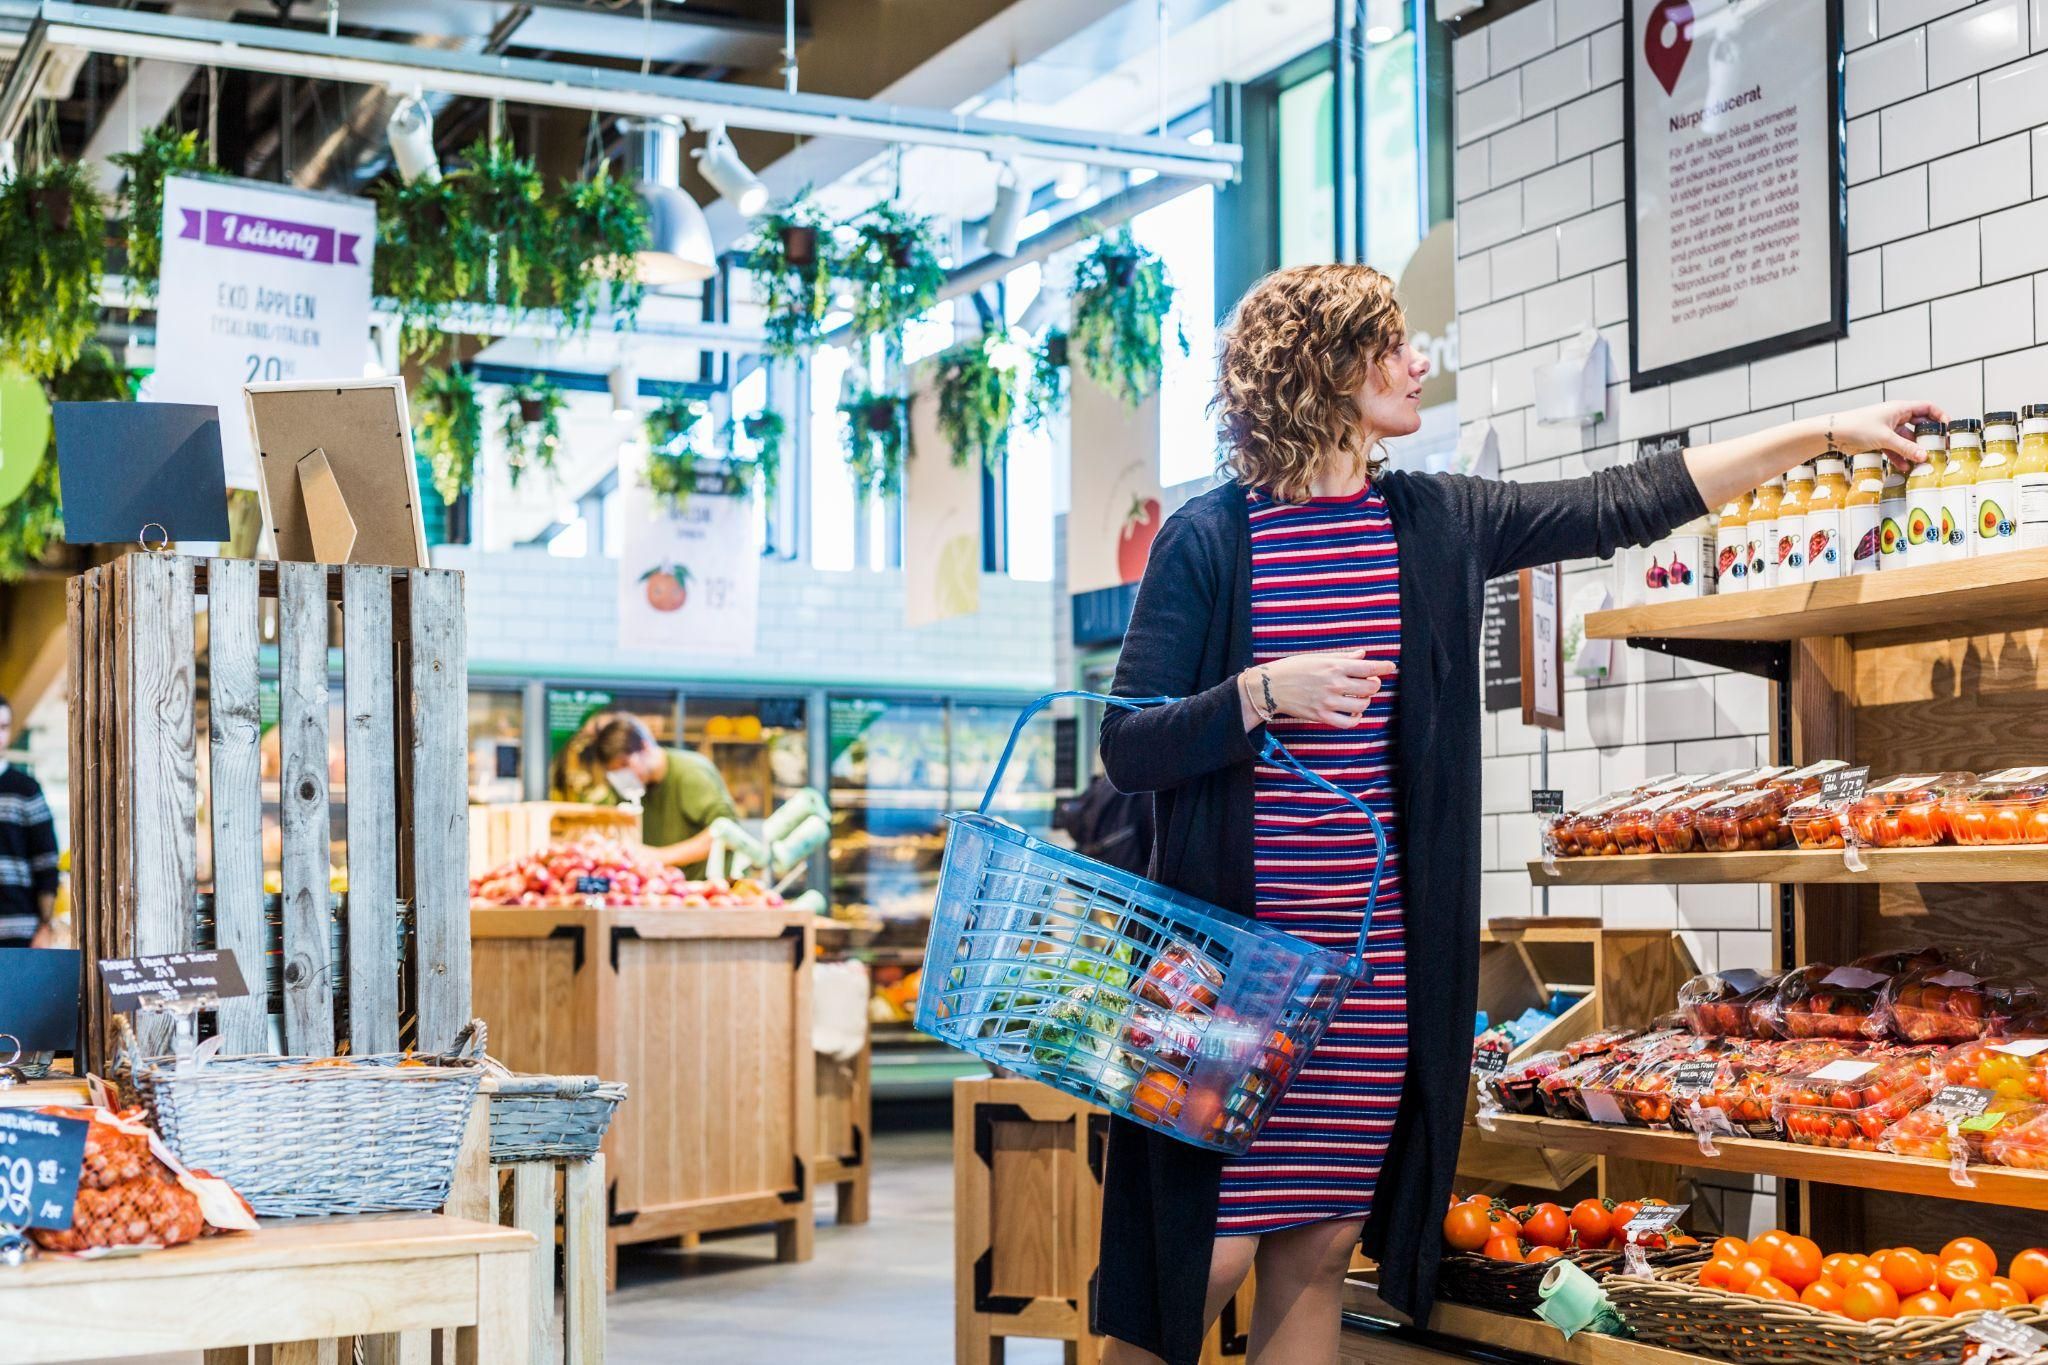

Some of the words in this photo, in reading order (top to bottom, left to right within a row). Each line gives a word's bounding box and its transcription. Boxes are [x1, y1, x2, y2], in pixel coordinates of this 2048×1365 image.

[1670, 161, 1686, 173] med
[1690, 156, 1704, 167] den
[1708, 145, 1734, 160] högsta
[1774, 122, 1797, 138] börjar
[1685, 142, 1694, 154] att
[1697, 137, 1712, 149] hitta
[1715, 131, 1727, 143] det
[1729, 123, 1751, 138] bästa
[1753, 104, 1797, 129] sortimentet
[1686, 166, 1716, 183] sökande
[1718, 159, 1741, 173] precis
[1744, 147, 1770, 163] utanför
[1706, 178, 1729, 191] lokala
[1730, 169, 1754, 183] odlare
[1757, 162, 1773, 175] som
[1775, 154, 1798, 168] förser
[1670, 209, 1683, 219] oss
[1685, 202, 1701, 213] med
[1722, 190, 1736, 201] och
[1762, 177, 1774, 187] när
[1777, 173, 1787, 183] de
[1790, 169, 1798, 179] är
[1671, 223, 1686, 234] som
[1715, 206, 1735, 220] Detta
[1738, 202, 1746, 212] är
[1750, 199, 1761, 208] en
[1764, 183, 1799, 202] värdefull
[222, 215, 236, 241] I
[237, 220, 320, 260] säsong
[1671, 238, 1682, 249] del
[1684, 237, 1691, 245] av
[1694, 229, 1708, 241] vårt
[1738, 217, 1747, 228] att
[1749, 210, 1773, 223] kunna
[1775, 201, 1799, 216] stödja
[1671, 251, 1686, 264] små
[1688, 238, 1732, 259] producenter
[1734, 232, 1748, 244] och
[1708, 255, 1725, 268] Leta
[1730, 248, 1747, 261] efter
[1753, 233, 1799, 253] märkningen
[1736, 264, 1746, 274] för
[1751, 259, 1761, 270] att
[1766, 253, 1785, 266] njuta
[1790, 248, 1799, 258] av
[218, 282, 248, 310] EKO
[1672, 296, 1693, 309] dessa
[1695, 285, 1731, 302] smakfulla
[1733, 279, 1748, 291] och
[1750, 271, 1779, 285] fräscha
[1683, 309, 1697, 320] och
[246, 354, 281, 382] 20
